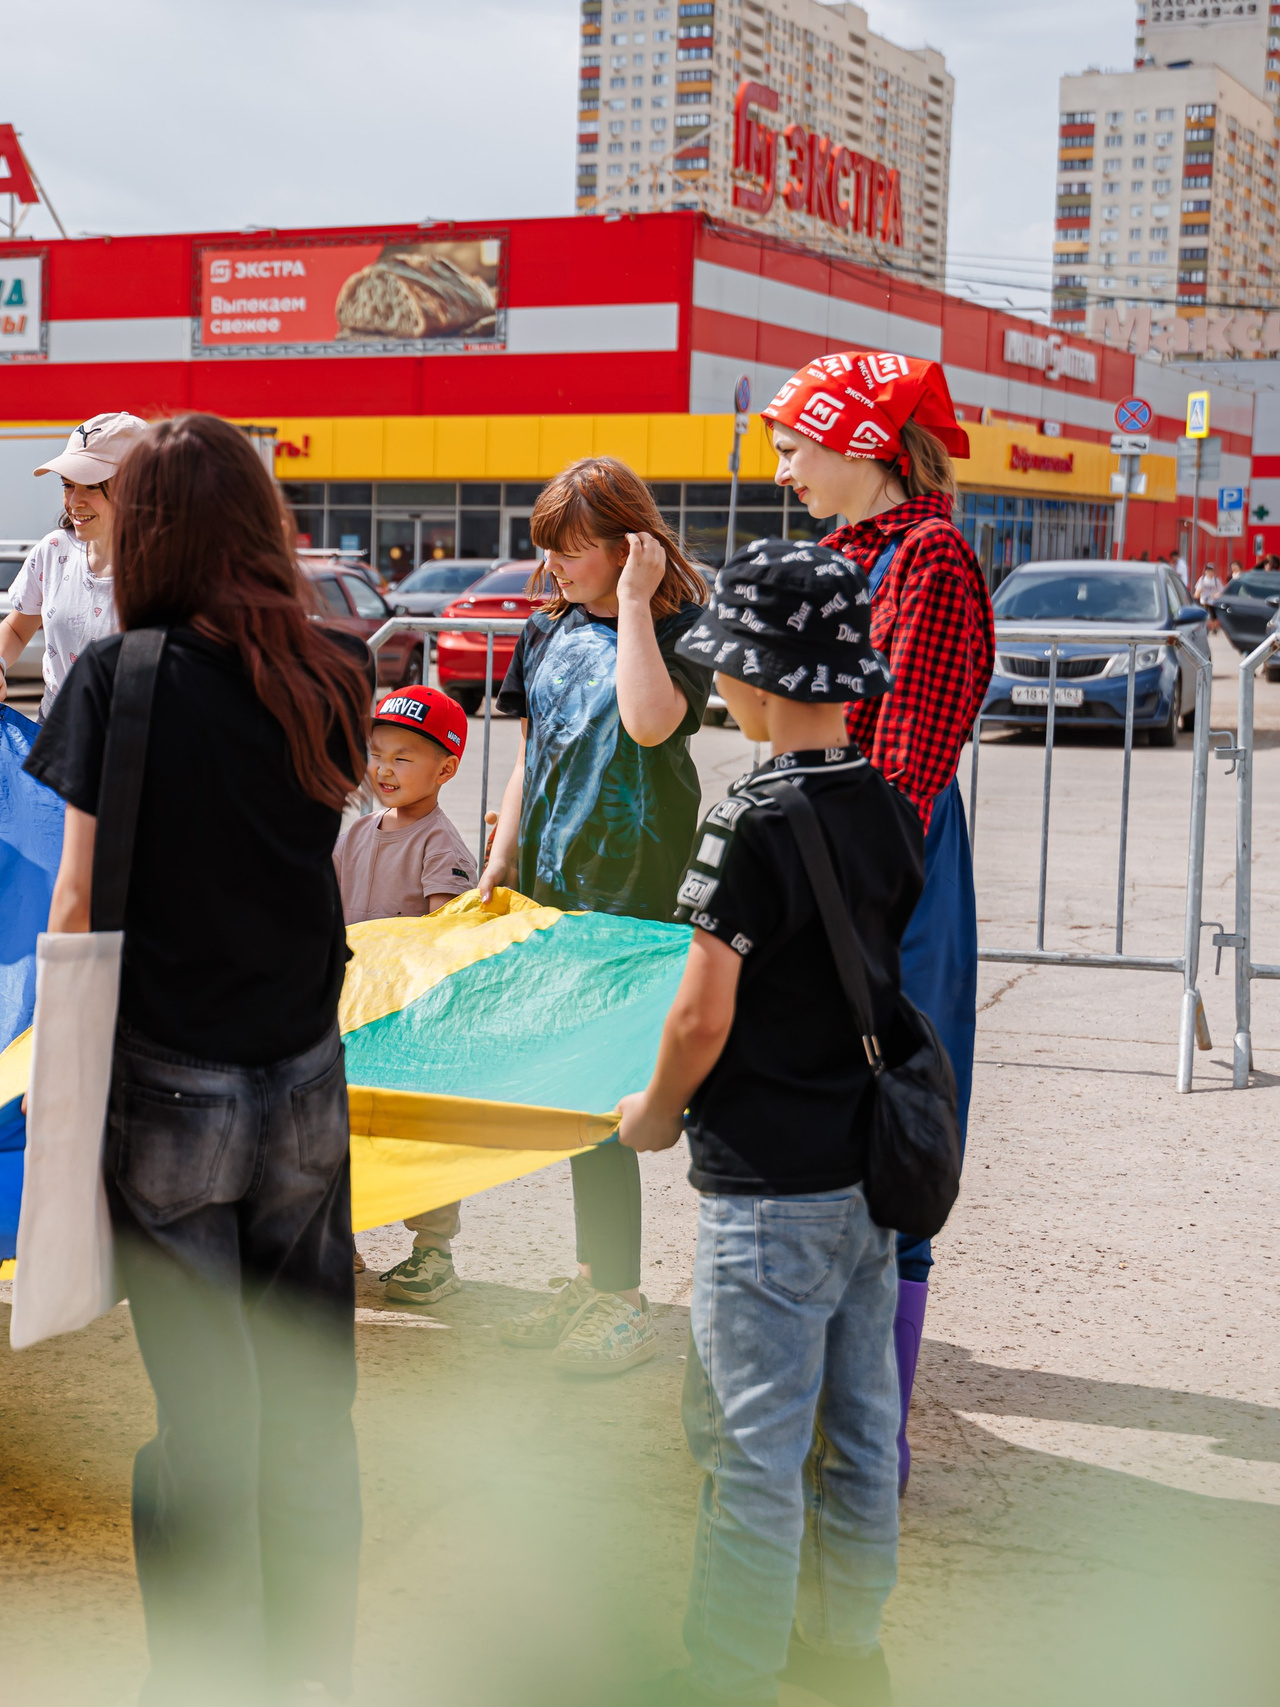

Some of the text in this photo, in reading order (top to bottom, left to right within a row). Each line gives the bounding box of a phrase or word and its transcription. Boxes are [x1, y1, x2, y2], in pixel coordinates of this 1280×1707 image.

[782, 124, 905, 247] ЭКСТРА
[234, 260, 306, 279] ЭКСТРА
[210, 296, 306, 314] Выпекаем
[210, 317, 281, 334] свежее
[857, 359, 875, 390] ЭКСТРА
[844, 386, 875, 409] ЭКСТРА
[793, 422, 824, 443] ЭКСТРА
[844, 450, 876, 460] ЭКСТРА
[734, 584, 759, 601] Dior
[787, 601, 813, 632] Dior
[820, 592, 849, 619] Dior
[740, 608, 768, 632] Dior
[837, 624, 861, 644] Dior
[779, 665, 809, 692] Dior
[811, 664, 829, 693] Dior
[836, 673, 865, 693] Dior
[380, 698, 423, 722] MARVEL
